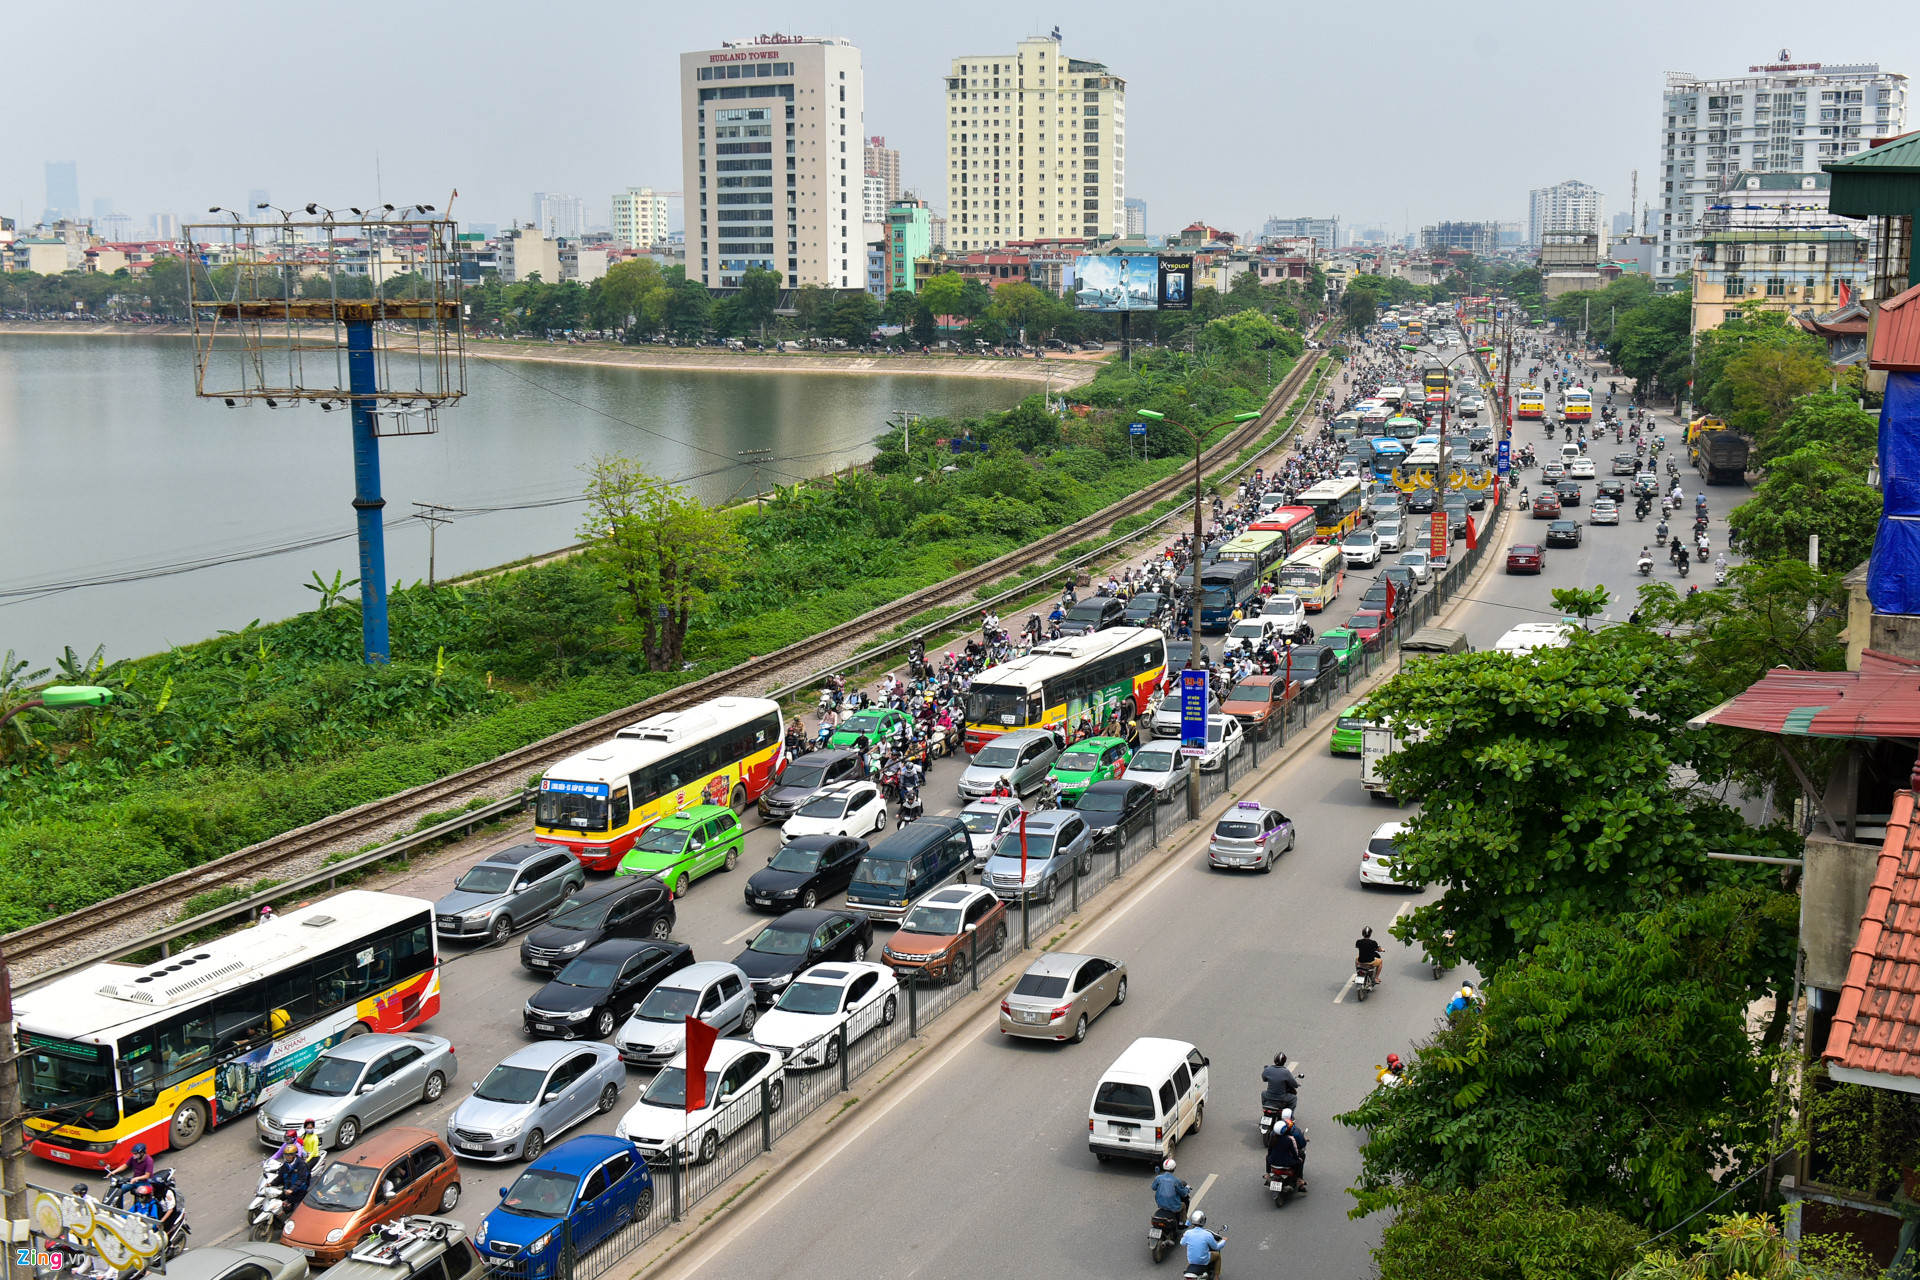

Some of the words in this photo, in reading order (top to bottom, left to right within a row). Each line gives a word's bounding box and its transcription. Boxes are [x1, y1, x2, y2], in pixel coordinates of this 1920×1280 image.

[794, 36, 803, 44] 12
[710, 52, 746, 62] HUDLAND
[748, 51, 779, 60] TOWER
[1184, 677, 1204, 686] 19-5
[543, 781, 548, 789] 8
[274, 1047, 283, 1056] AN
[284, 1036, 306, 1050] KHANH
